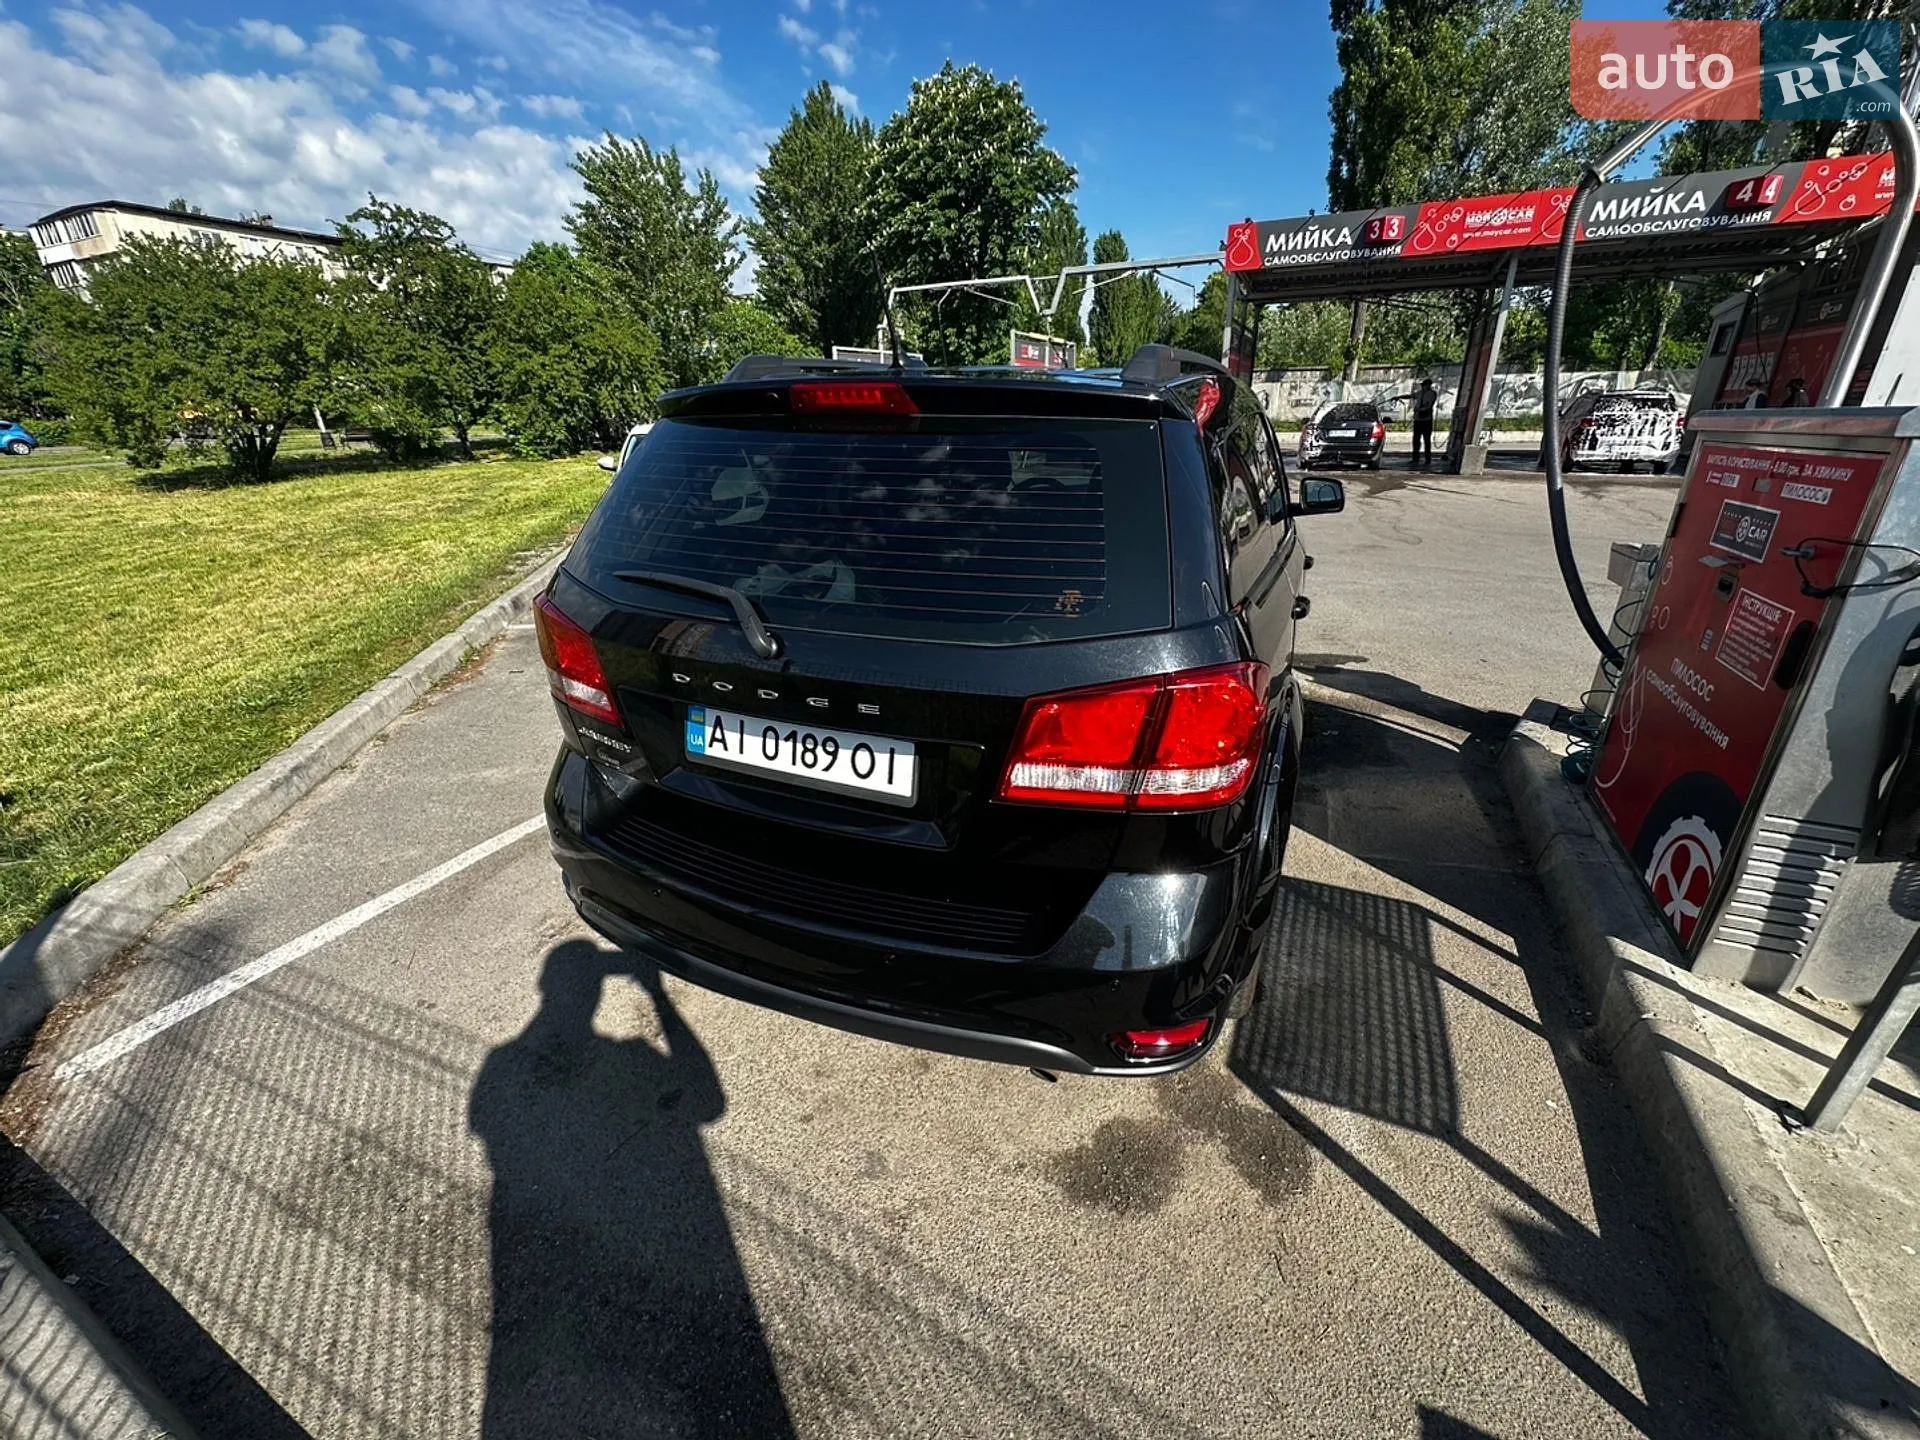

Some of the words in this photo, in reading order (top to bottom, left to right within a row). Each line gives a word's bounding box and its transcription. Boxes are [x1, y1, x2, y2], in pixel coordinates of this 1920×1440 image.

[1736, 181, 1754, 202] 4
[1763, 178, 1779, 200] 4
[1588, 186, 1707, 223] МИЙКА
[1369, 220, 1381, 239] 3
[1388, 217, 1400, 238] 3
[1585, 210, 1772, 238] САМООБСЛУГОВУВАННЯ
[1265, 225, 1353, 253] МИЙКА
[1264, 245, 1402, 267] САМООБСЛУГОВУВАННЯ
[1748, 525, 1768, 541] CAR
[1670, 657, 1714, 702] ПИЛОСОС
[672, 672, 881, 715] DODGE
[690, 734, 704, 746] UA
[762, 725, 840, 772] 0189
